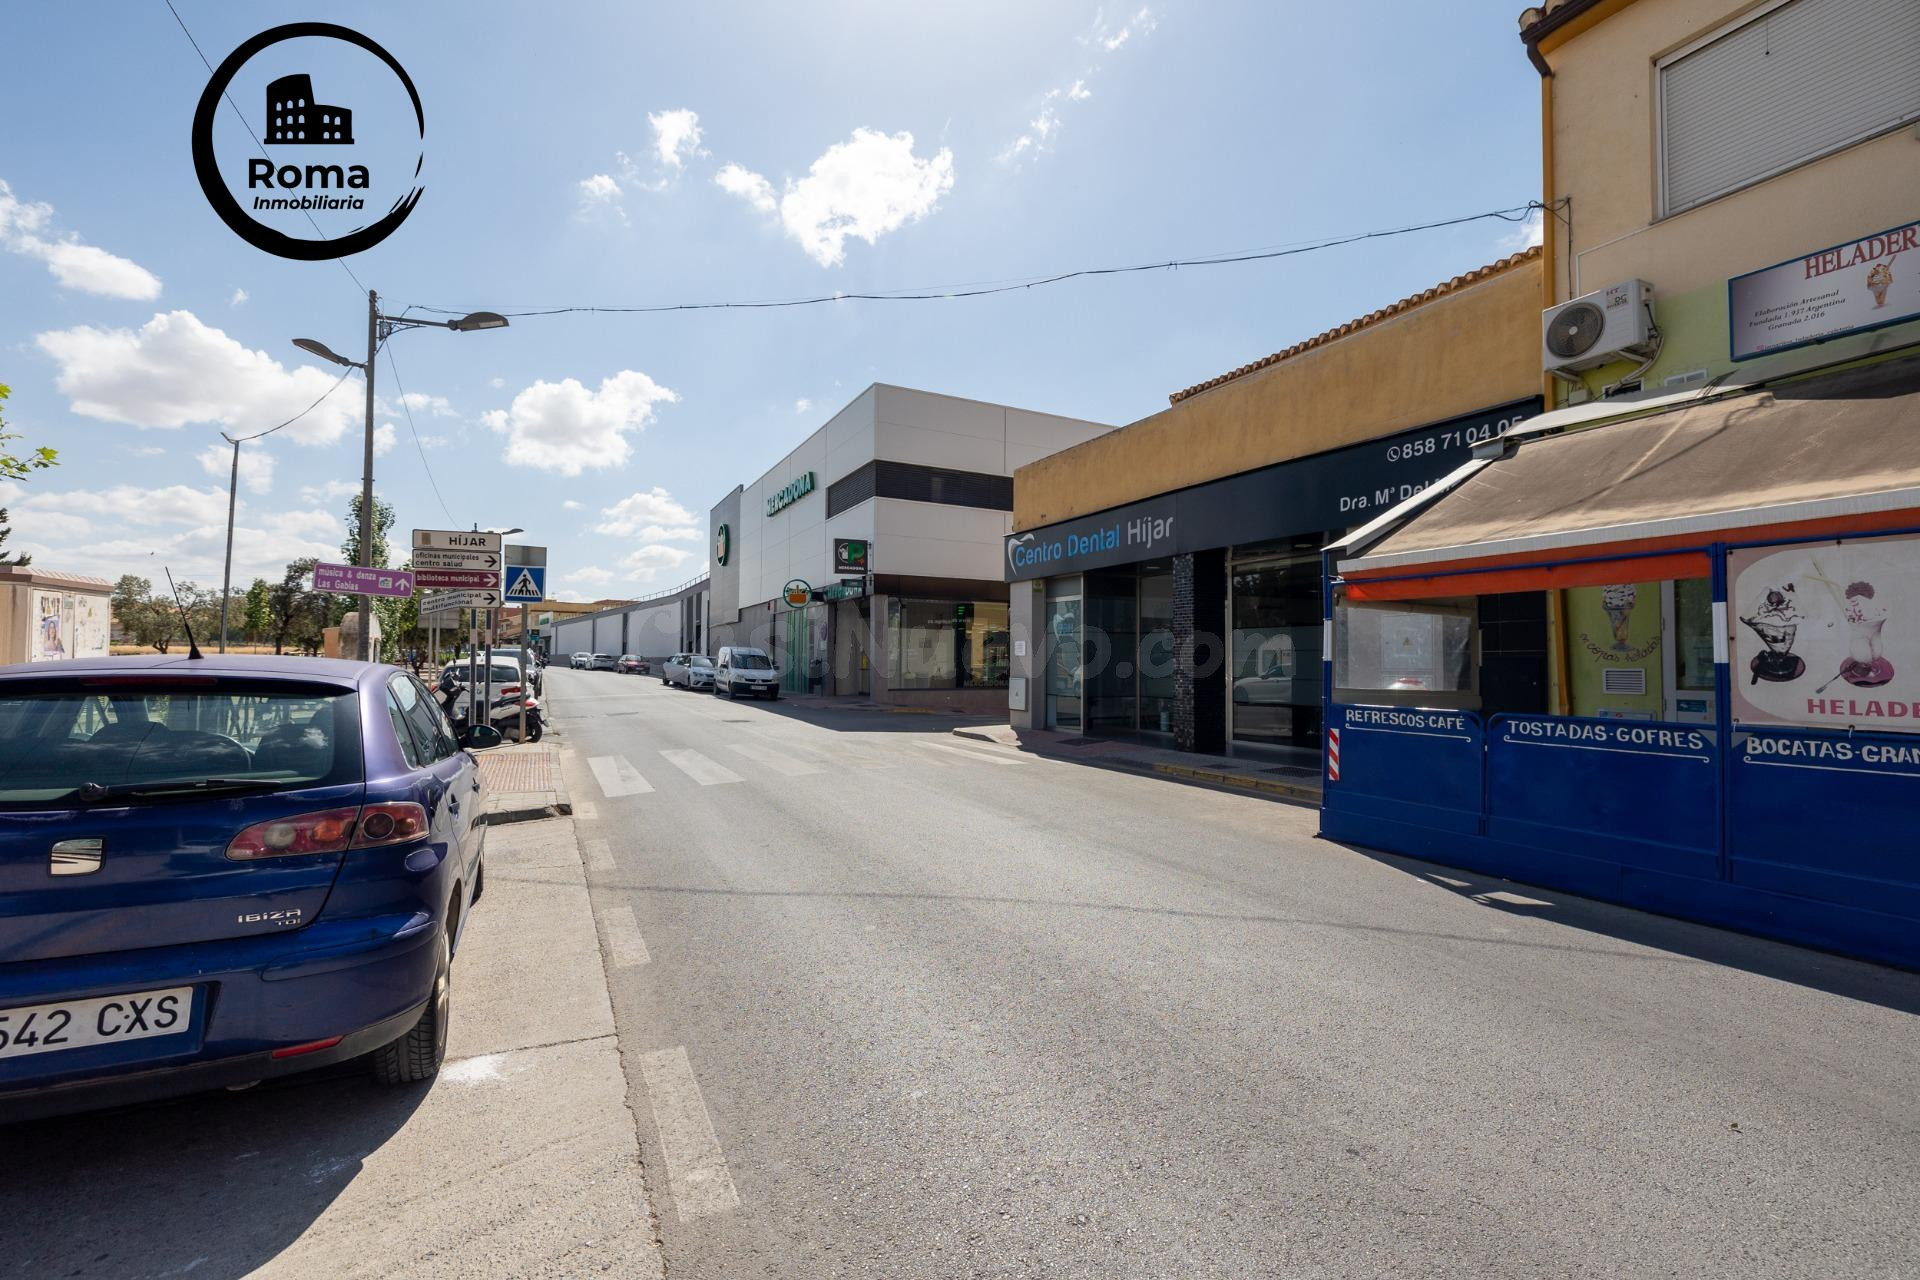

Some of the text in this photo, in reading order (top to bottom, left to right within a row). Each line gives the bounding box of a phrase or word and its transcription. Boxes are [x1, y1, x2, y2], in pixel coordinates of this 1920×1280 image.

[1800, 289, 1840, 306] Artesanal
[1806, 298, 1846, 313] Argentina
[1768, 318, 1802, 331] Granada
[1402, 438, 1436, 459] 858
[767, 471, 814, 517] MERCADONA
[1340, 494, 1371, 512] Dra.
[449, 533, 487, 548] HÍJAR
[1015, 516, 1174, 567] Centro Dental Híjar
[415, 552, 479, 561] oficinas municipales
[442, 560, 463, 568] salud
[356, 570, 377, 581] danza
[416, 573, 480, 584] biblioteca municipal
[317, 578, 359, 591] Las Gabias
[422, 592, 482, 606] centro municipal
[422, 599, 473, 612] multifuncional
[97, 995, 179, 1037] CXS
